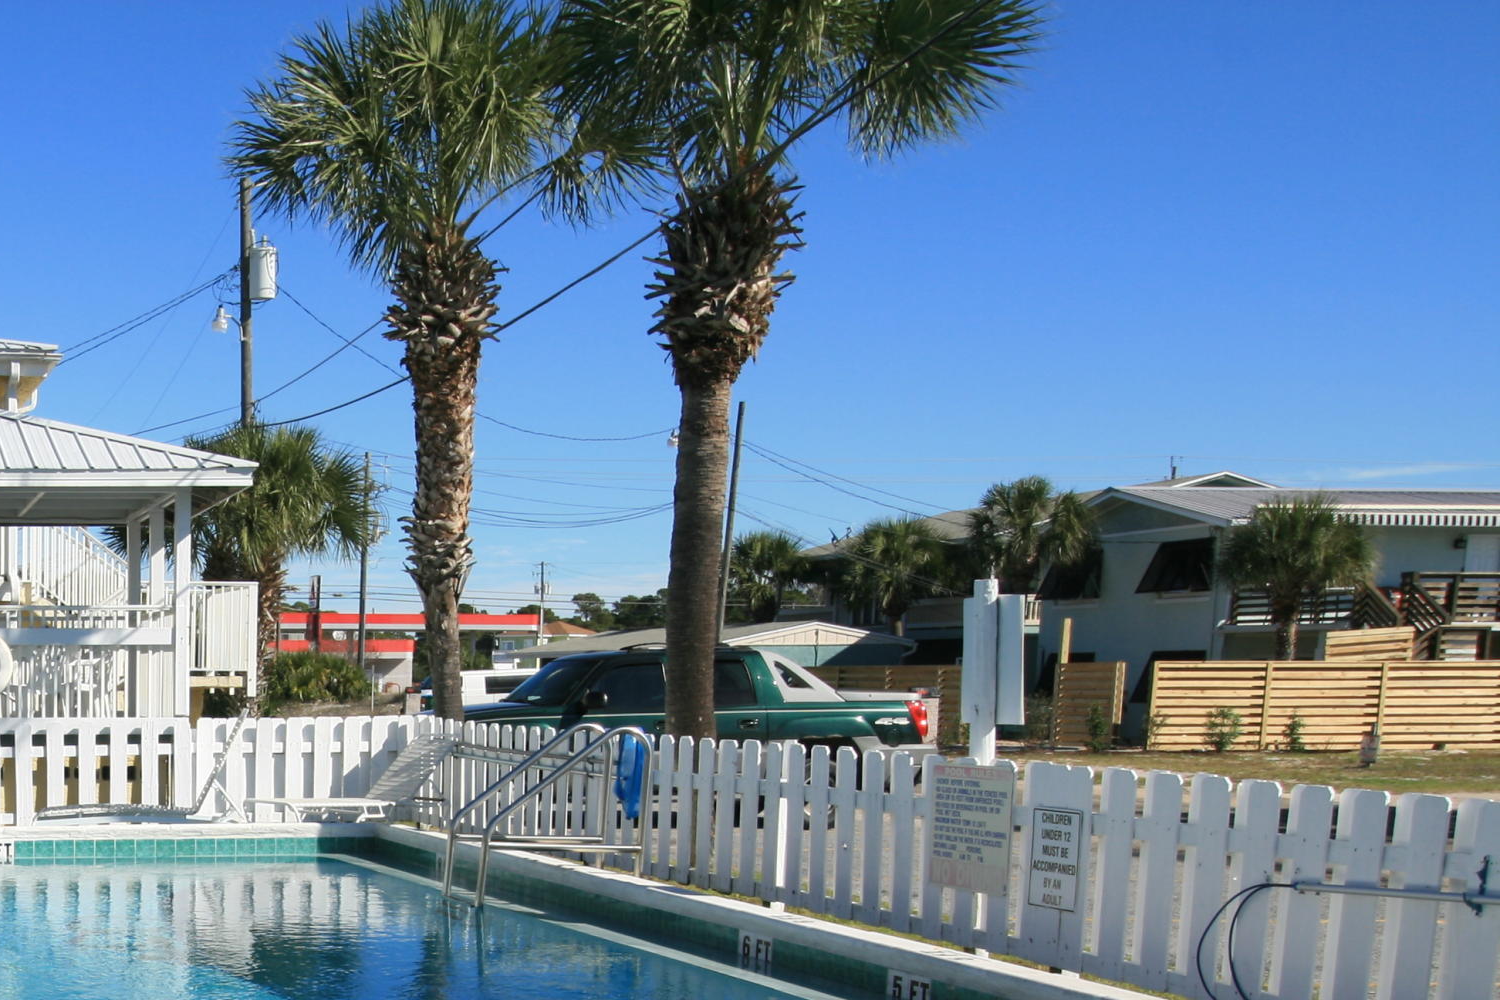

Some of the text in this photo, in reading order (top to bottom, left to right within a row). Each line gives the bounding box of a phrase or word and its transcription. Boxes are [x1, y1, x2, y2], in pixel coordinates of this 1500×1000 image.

[1041, 812, 1072, 826] CHILDREN
[1041, 829, 1071, 842] UNDER 12
[1042, 845, 1068, 858] MUST BE
[1033, 859, 1076, 875] ACCOMPANIED
[1043, 877, 1061, 890] BY AN
[1042, 893, 1062, 906] ADULT
[742, 935, 771, 961] 6 FT
[892, 975, 902, 998] 5
